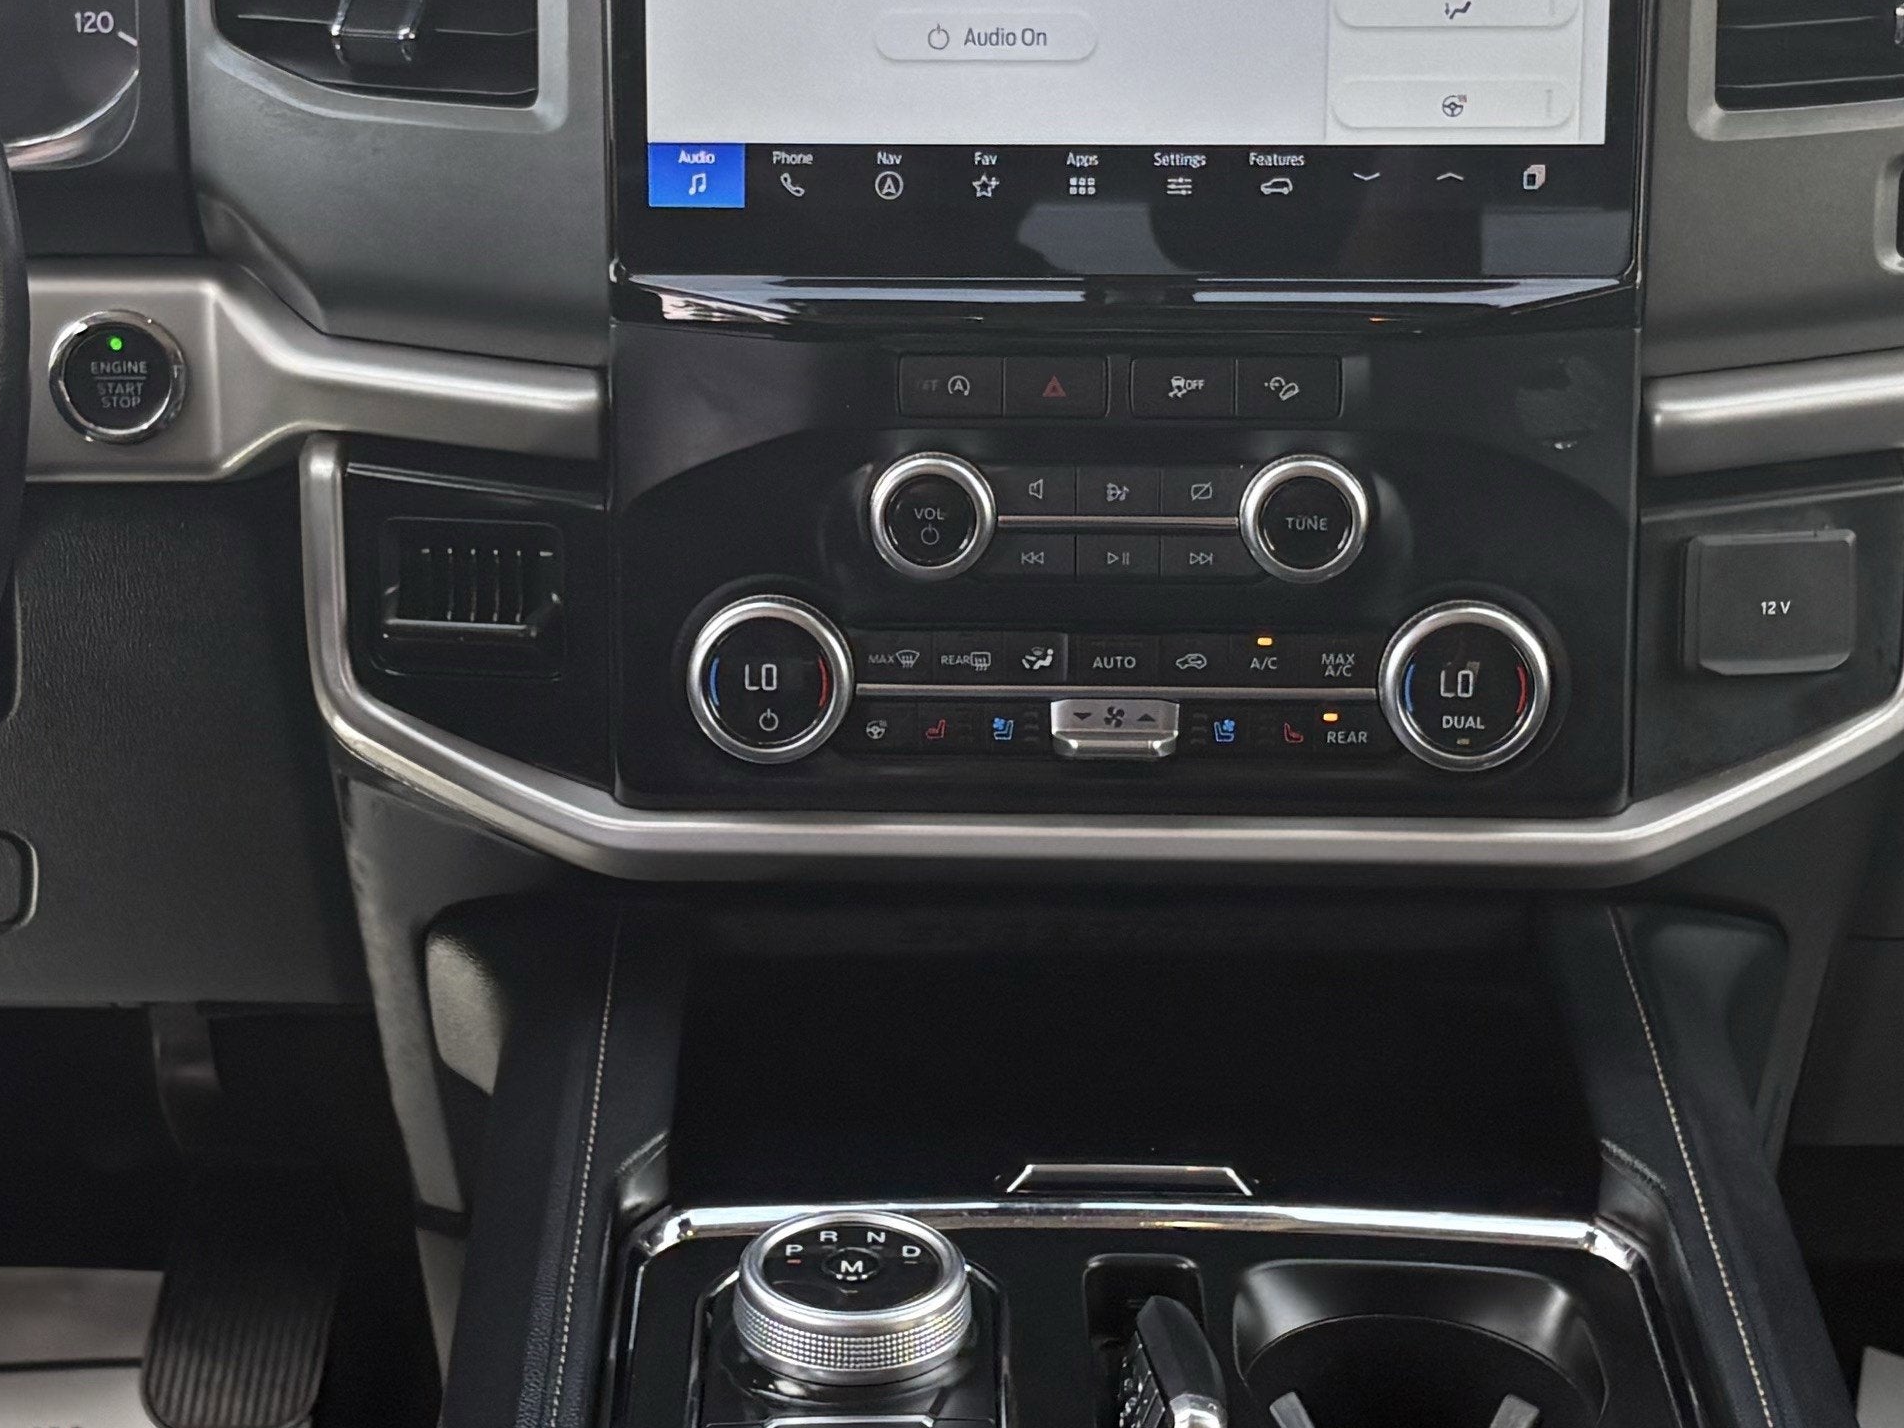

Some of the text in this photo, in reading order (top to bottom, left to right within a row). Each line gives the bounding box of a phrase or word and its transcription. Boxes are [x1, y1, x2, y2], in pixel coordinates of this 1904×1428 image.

[74, 11, 115, 34] 120
[964, 26, 1048, 47] Audio On
[677, 149, 716, 165] Audio
[772, 150, 814, 166] Phone
[877, 150, 903, 166] Nav
[974, 151, 998, 166] Fav
[1066, 151, 1099, 168] Apps
[1153, 151, 1207, 169] Settings
[1248, 151, 1305, 167] Features
[90, 360, 148, 374] ENGINE
[97, 382, 144, 396] START
[1186, 379, 1206, 391] OFF
[100, 395, 142, 409] STOP
[914, 508, 945, 521] VOL
[1285, 516, 1328, 531] TUNE
[1761, 600, 1791, 615] 12 V
[868, 653, 895, 665] MAX
[940, 654, 971, 665] REAR
[1092, 656, 1137, 669] AUTO
[1250, 656, 1278, 671] A/C
[1321, 653, 1356, 666] MAX
[744, 663, 778, 691] LO
[1324, 665, 1353, 678] A/C
[1440, 669, 1474, 698] LO
[1442, 715, 1486, 730] DUAL
[1326, 730, 1368, 744] REAR
[785, 1230, 922, 1258] P R N D
[839, 1260, 864, 1273] M
